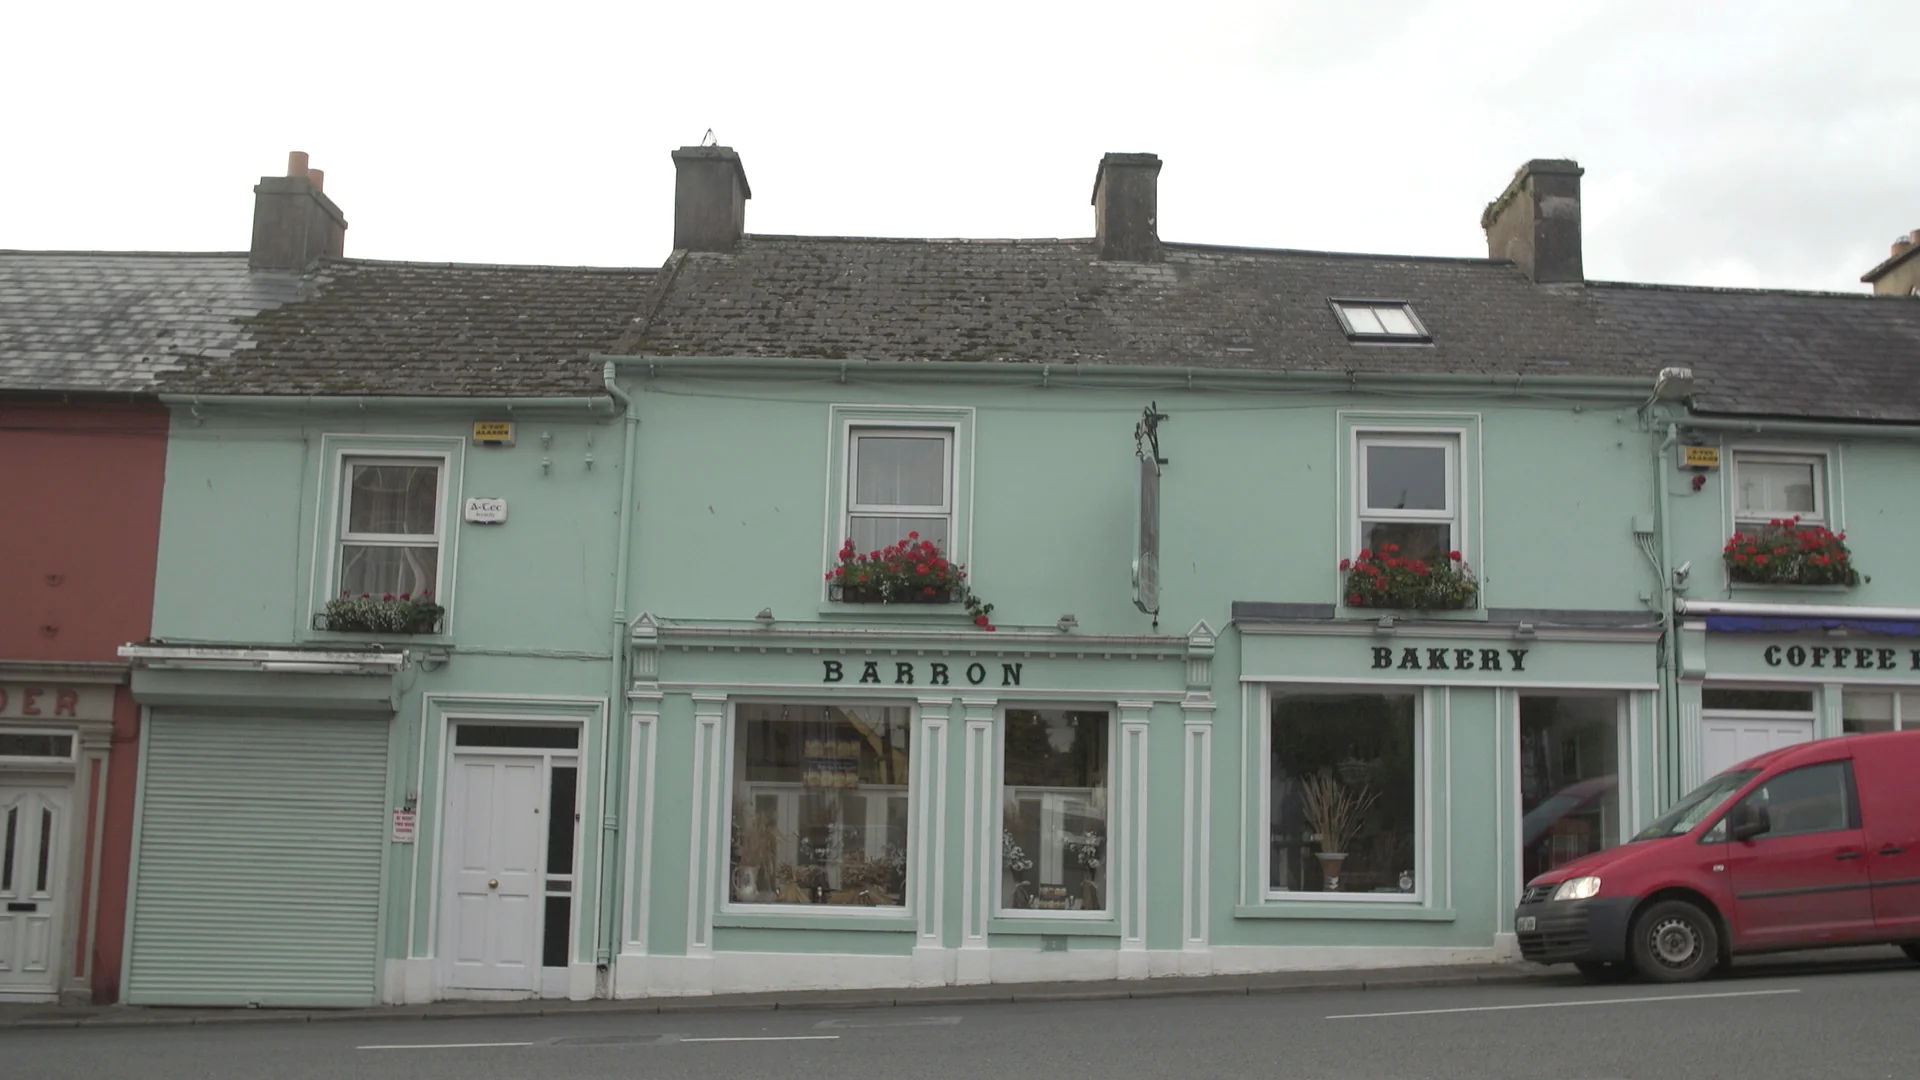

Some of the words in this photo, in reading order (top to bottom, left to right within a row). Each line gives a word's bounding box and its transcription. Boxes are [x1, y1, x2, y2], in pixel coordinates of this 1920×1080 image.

[1371, 647, 1529, 672] BAKERY
[1763, 644, 1897, 670] COFFEE
[822, 660, 1023, 686] BARRON
